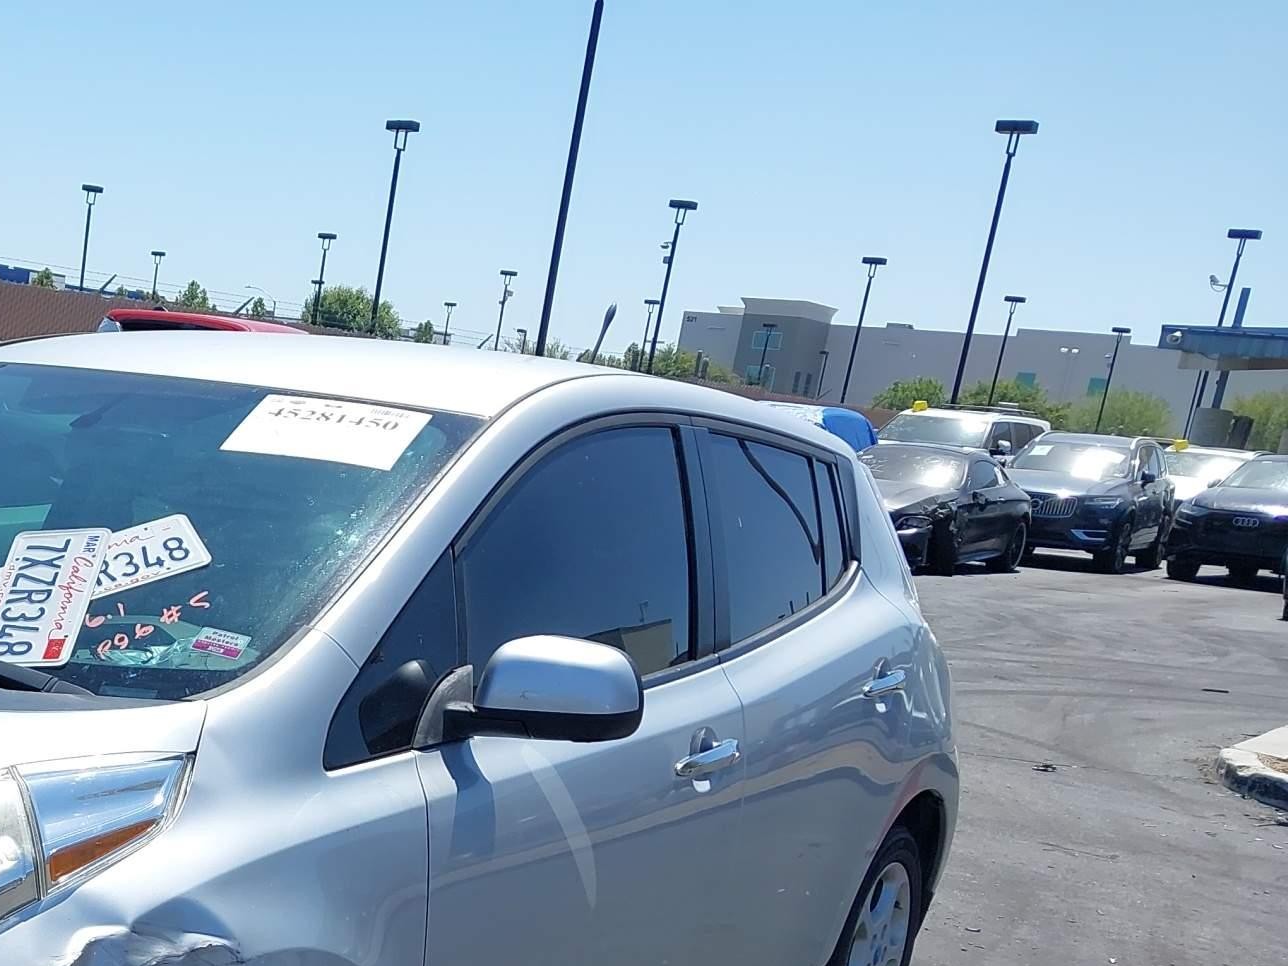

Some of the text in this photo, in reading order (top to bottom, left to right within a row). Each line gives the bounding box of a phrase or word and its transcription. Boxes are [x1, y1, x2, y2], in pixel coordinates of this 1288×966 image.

[268, 407, 400, 431] 45281450
[82, 535, 100, 553] MAR
[49, 556, 94, 639] California
